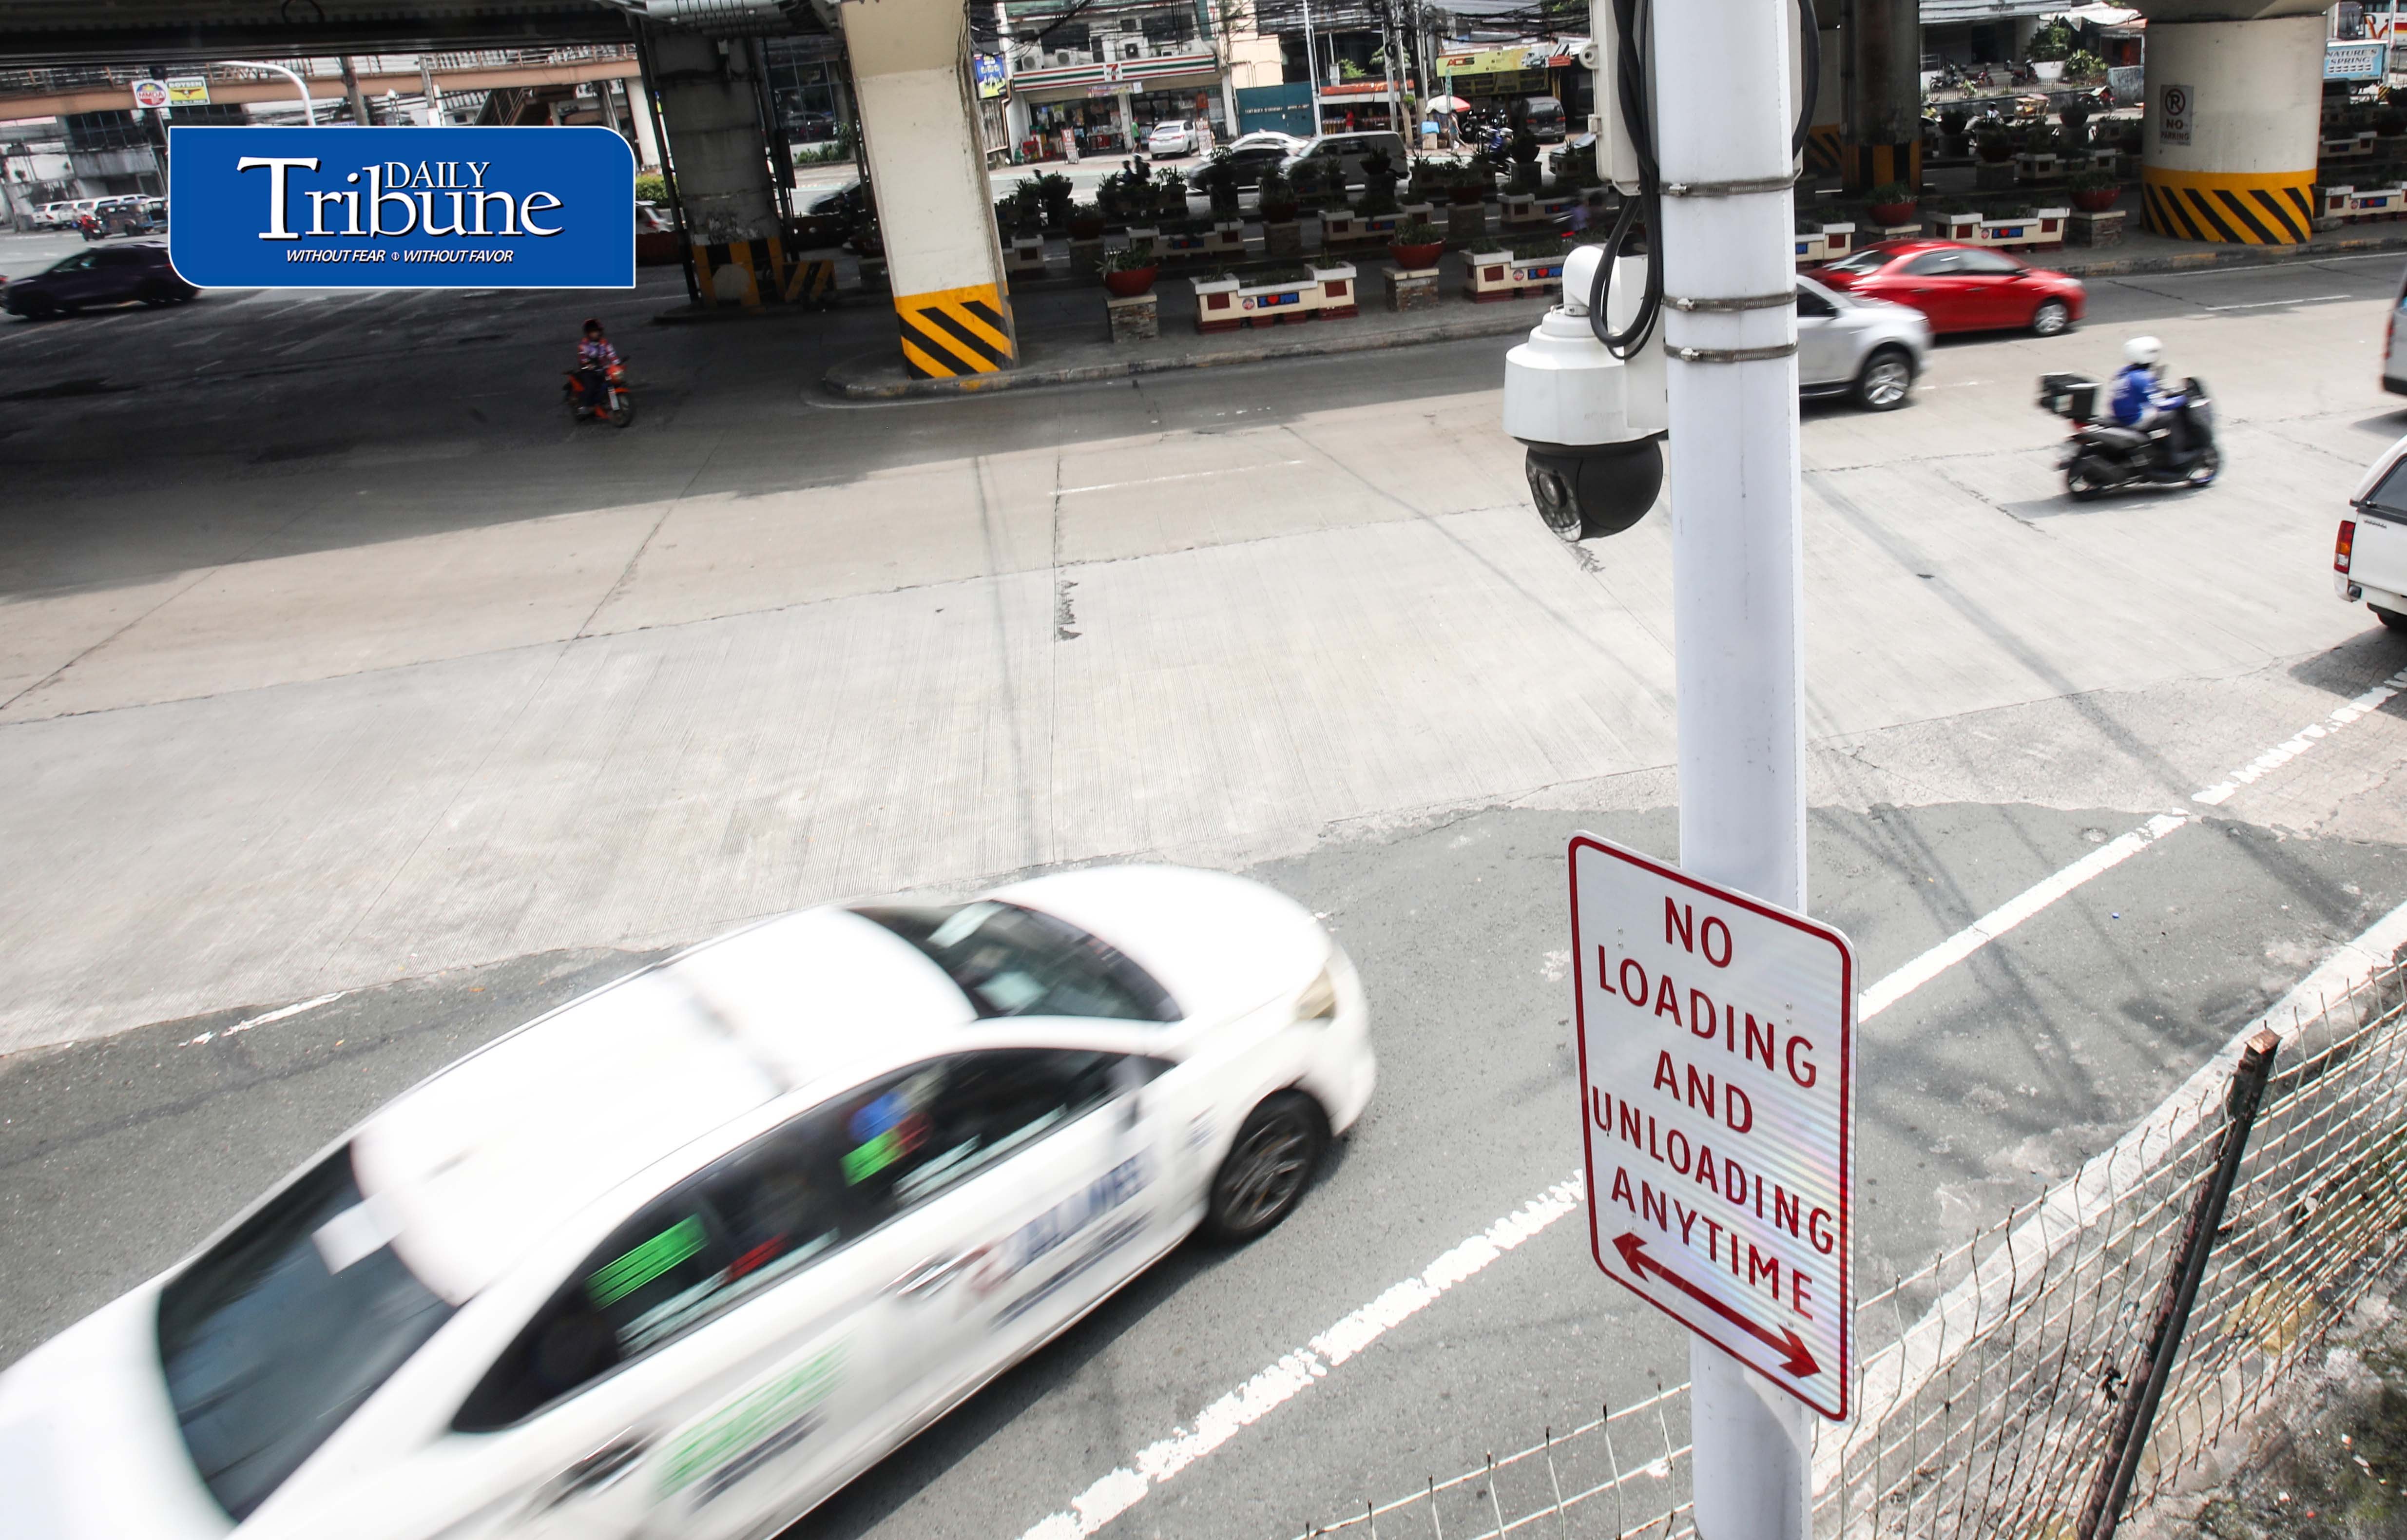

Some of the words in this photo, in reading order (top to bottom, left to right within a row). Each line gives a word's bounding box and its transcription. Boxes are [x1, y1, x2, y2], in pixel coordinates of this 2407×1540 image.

[1106, 63, 1118, 80] 7
[2326, 48, 2377, 58] NATURE'S
[2160, 131, 2189, 140] PARKING
[2166, 119, 2183, 129] NO
[1665, 896, 1733, 968] NO
[1598, 944, 1817, 1089] LOADING
[1654, 1050, 1753, 1135] AND
[1593, 1085, 1834, 1256] UNLOADING
[1612, 1166, 1814, 1321] ANYTIME
